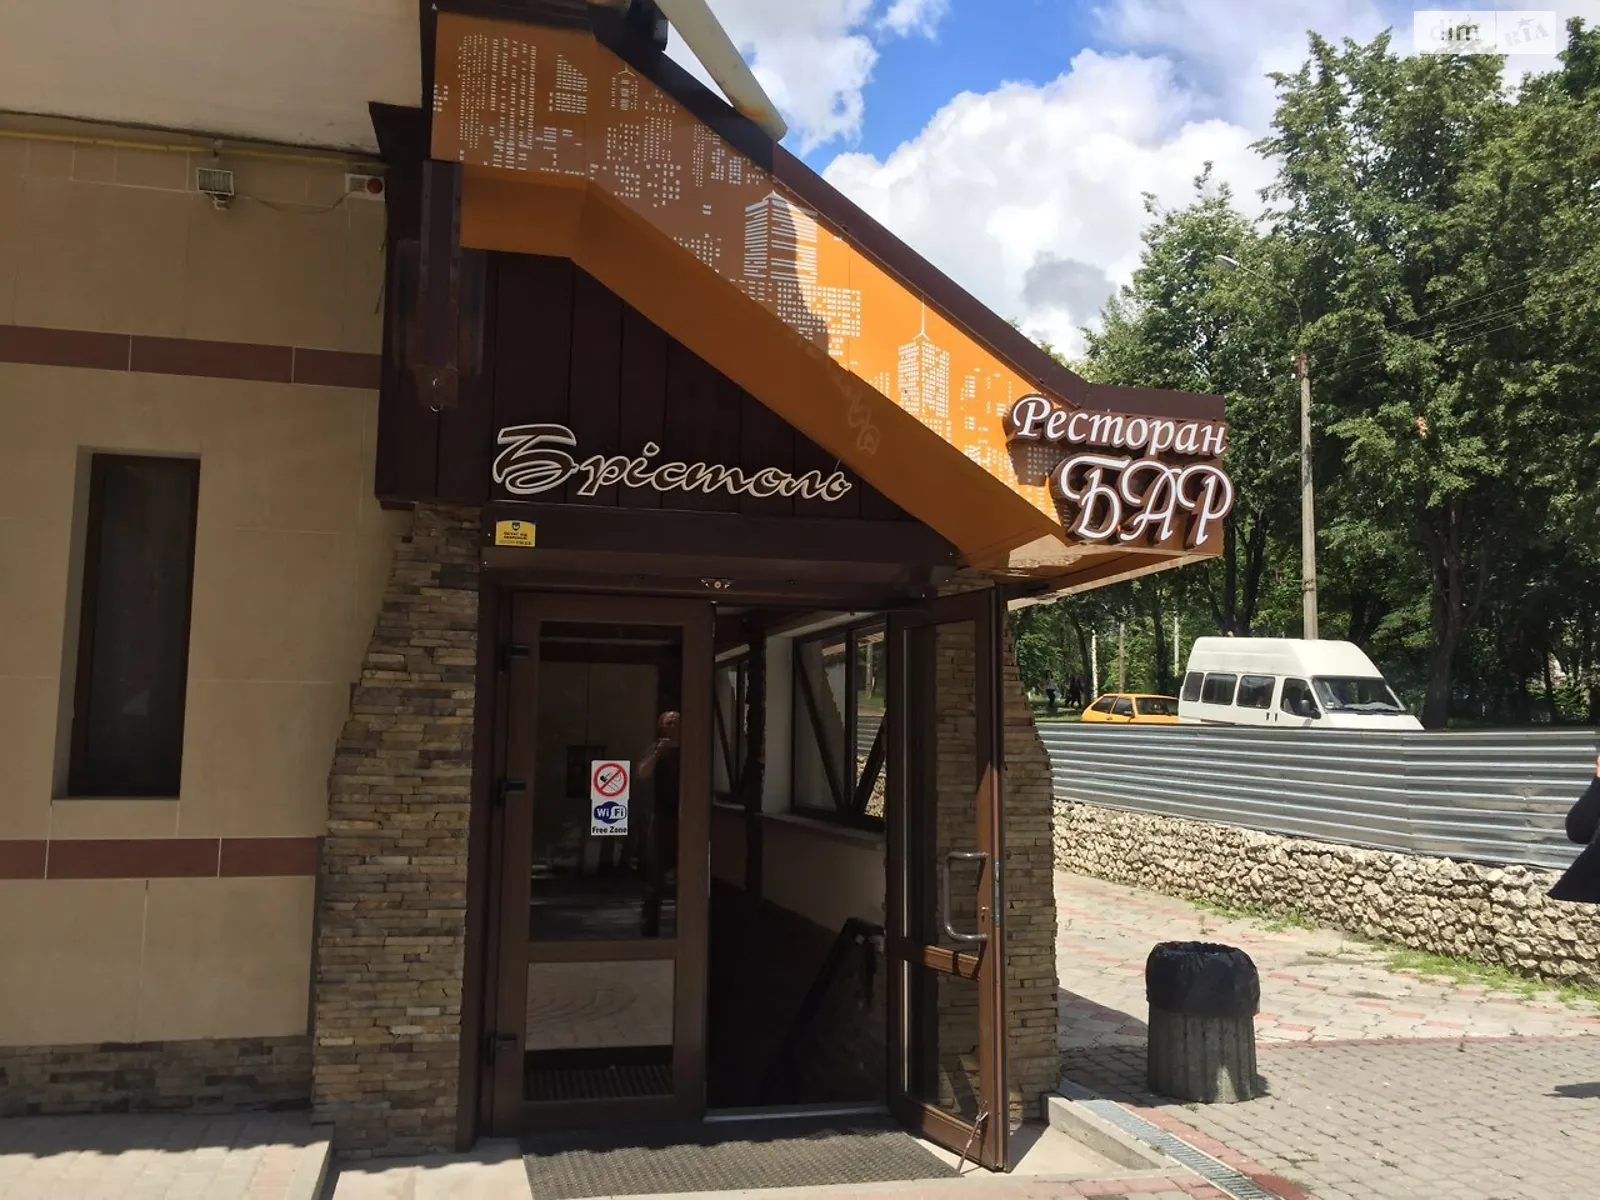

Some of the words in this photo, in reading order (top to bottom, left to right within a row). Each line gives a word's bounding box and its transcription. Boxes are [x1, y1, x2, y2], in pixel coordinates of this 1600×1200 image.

[1012, 396, 1227, 455] Ресторан
[492, 424, 853, 502] Брістоль
[1060, 455, 1234, 546] БАР
[592, 826, 608, 834] Free
[609, 826, 627, 834] Zone
